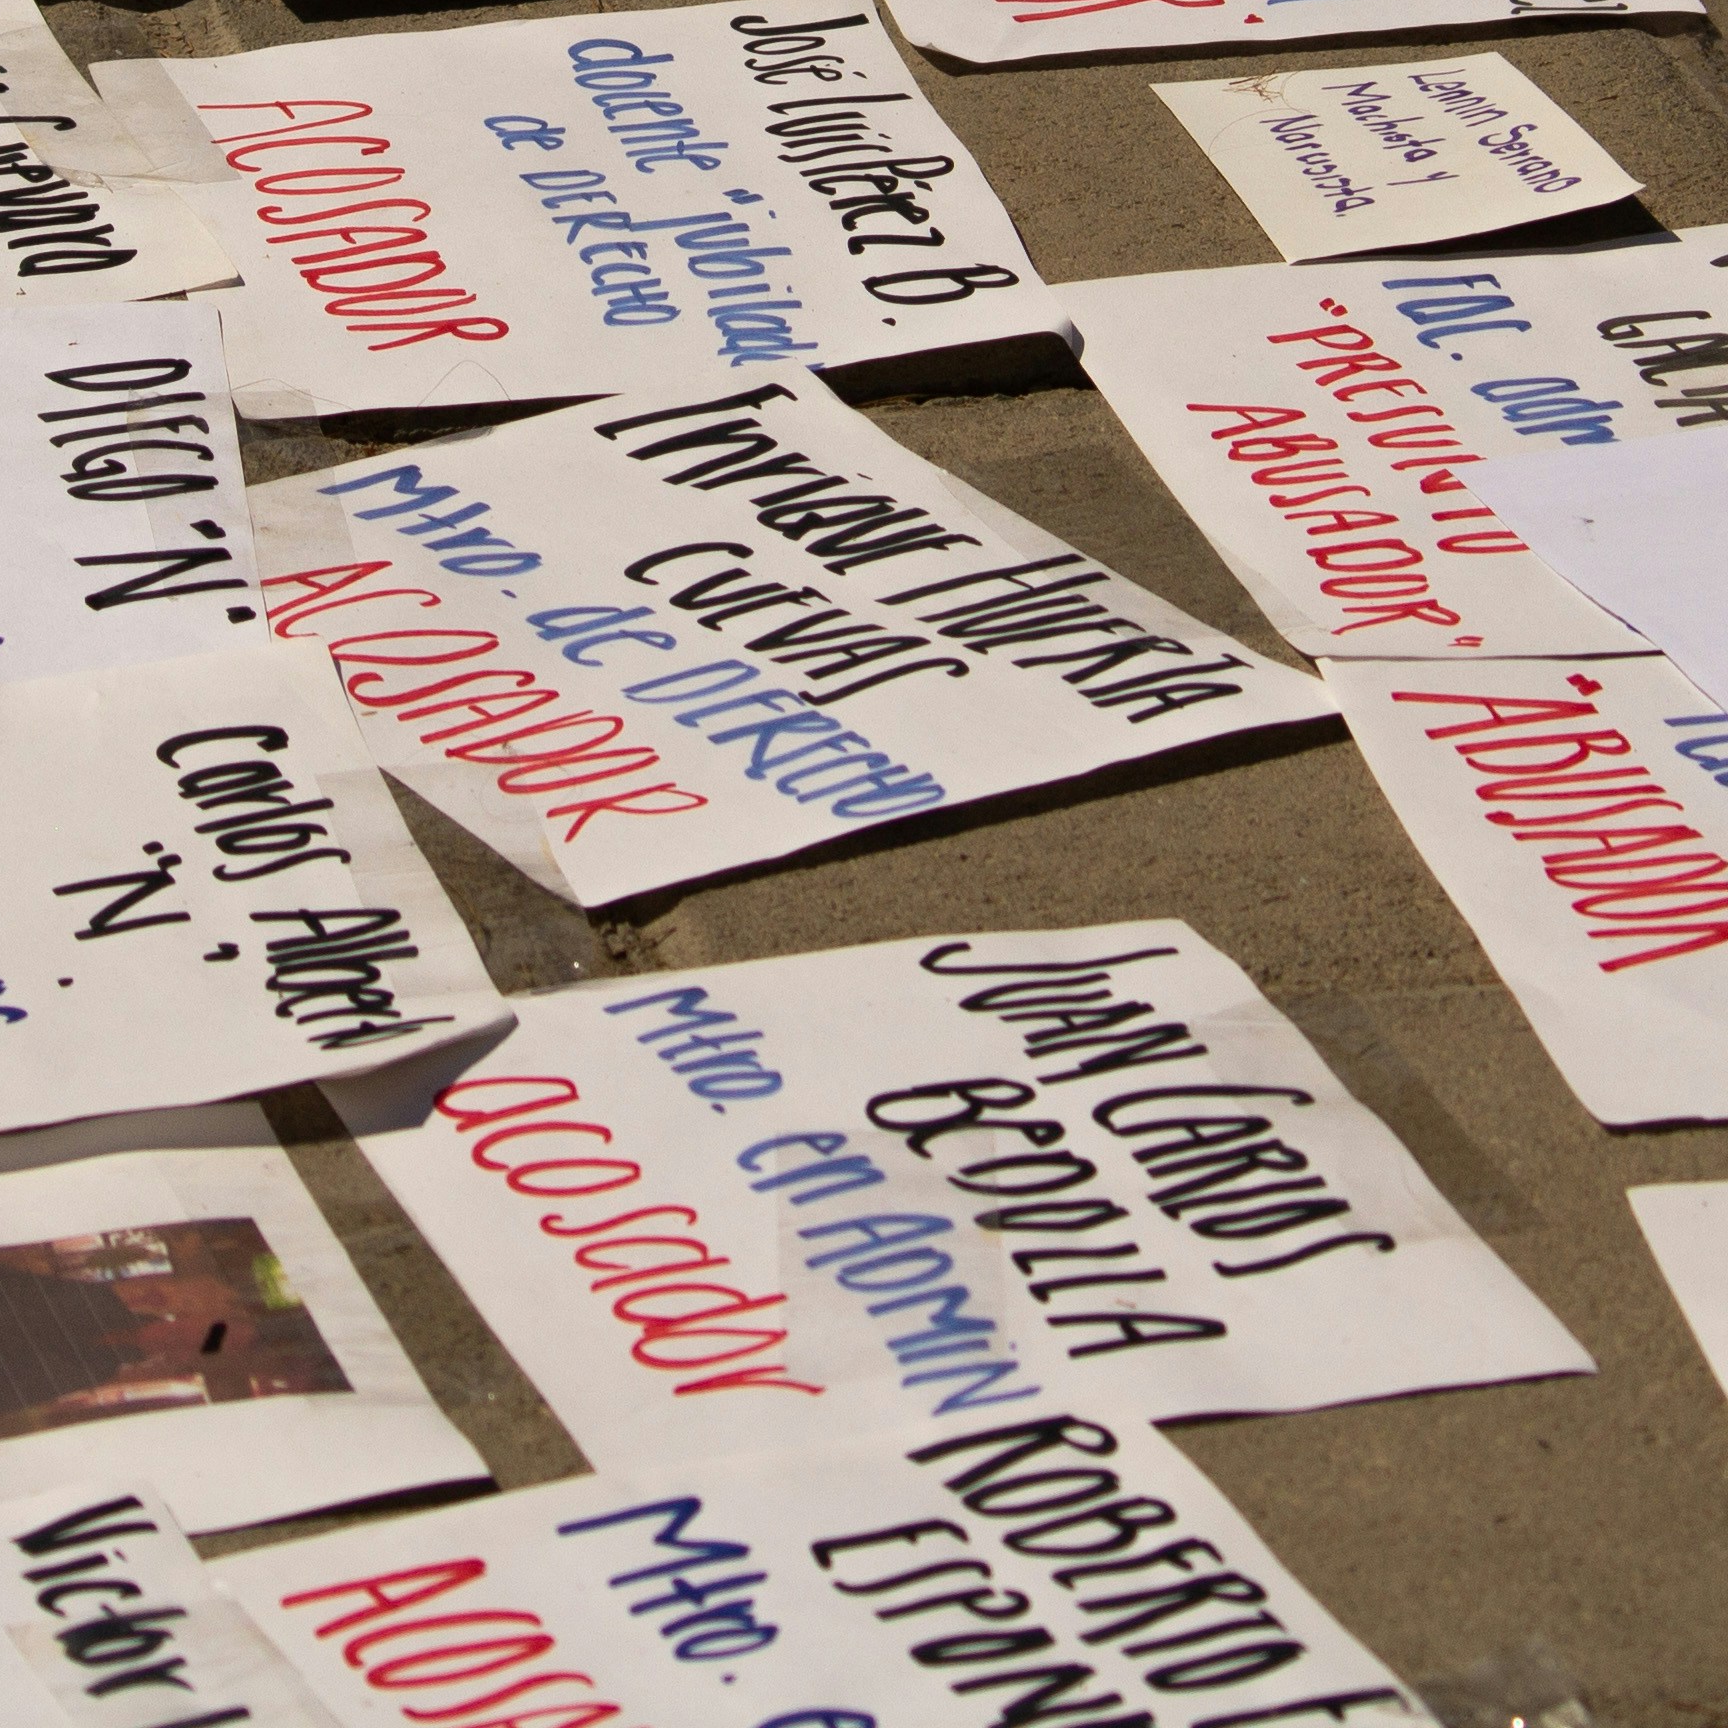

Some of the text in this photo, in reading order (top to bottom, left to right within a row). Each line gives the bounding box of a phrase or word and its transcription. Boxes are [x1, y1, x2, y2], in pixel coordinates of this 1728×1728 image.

[731, 14, 872, 84] José
[197, 101, 510, 351] ACOSADOR
[484, 116, 683, 326] de DERECHO
[38, 358, 220, 502] DIEGO
[259, 561, 709, 842] ACOSADOR
[526, 606, 948, 819] de DERECHO
[621, 541, 969, 705] CUEVAS
[875, 554, 1254, 724] HUERTA
[156, 725, 351, 882] Carlos
[739, 1133, 886, 1205] en
[920, 943, 1396, 1278] JUAN CARLOS
[433, 1076, 823, 1397] acosador
[12, 1495, 193, 1698] Victor
[907, 1415, 1304, 1694] ROBERTO
